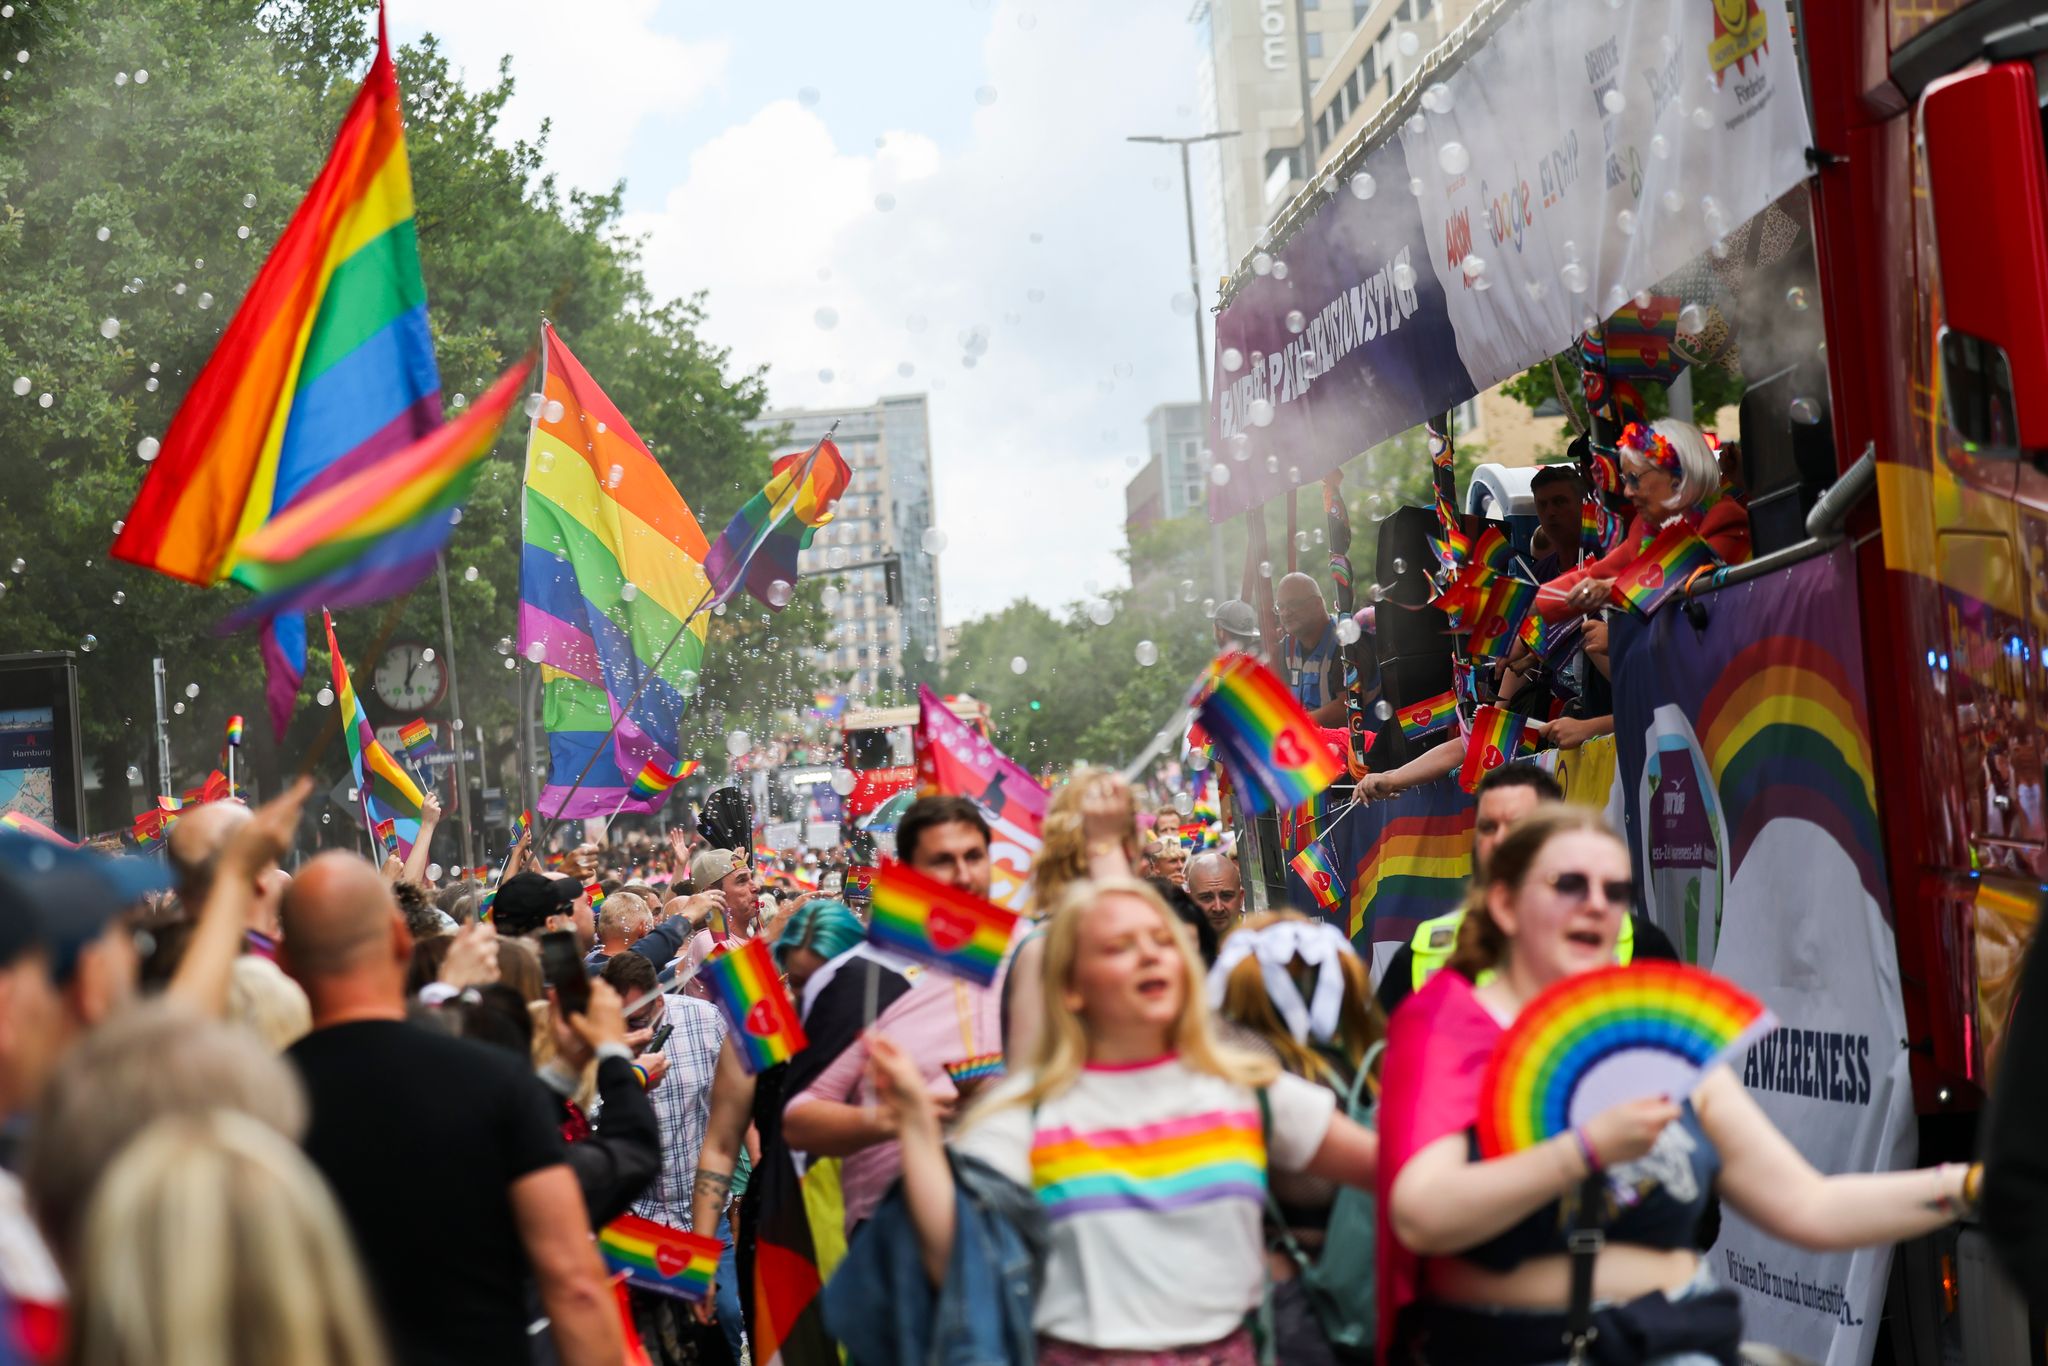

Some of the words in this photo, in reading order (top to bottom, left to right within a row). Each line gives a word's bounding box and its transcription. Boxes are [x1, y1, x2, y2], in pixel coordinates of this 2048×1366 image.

[1481, 161, 1532, 253] Google
[12, 749, 51, 758] Hamburg
[1744, 1027, 1871, 1106] AWARENESS
[1784, 1272, 1800, 1305] und
